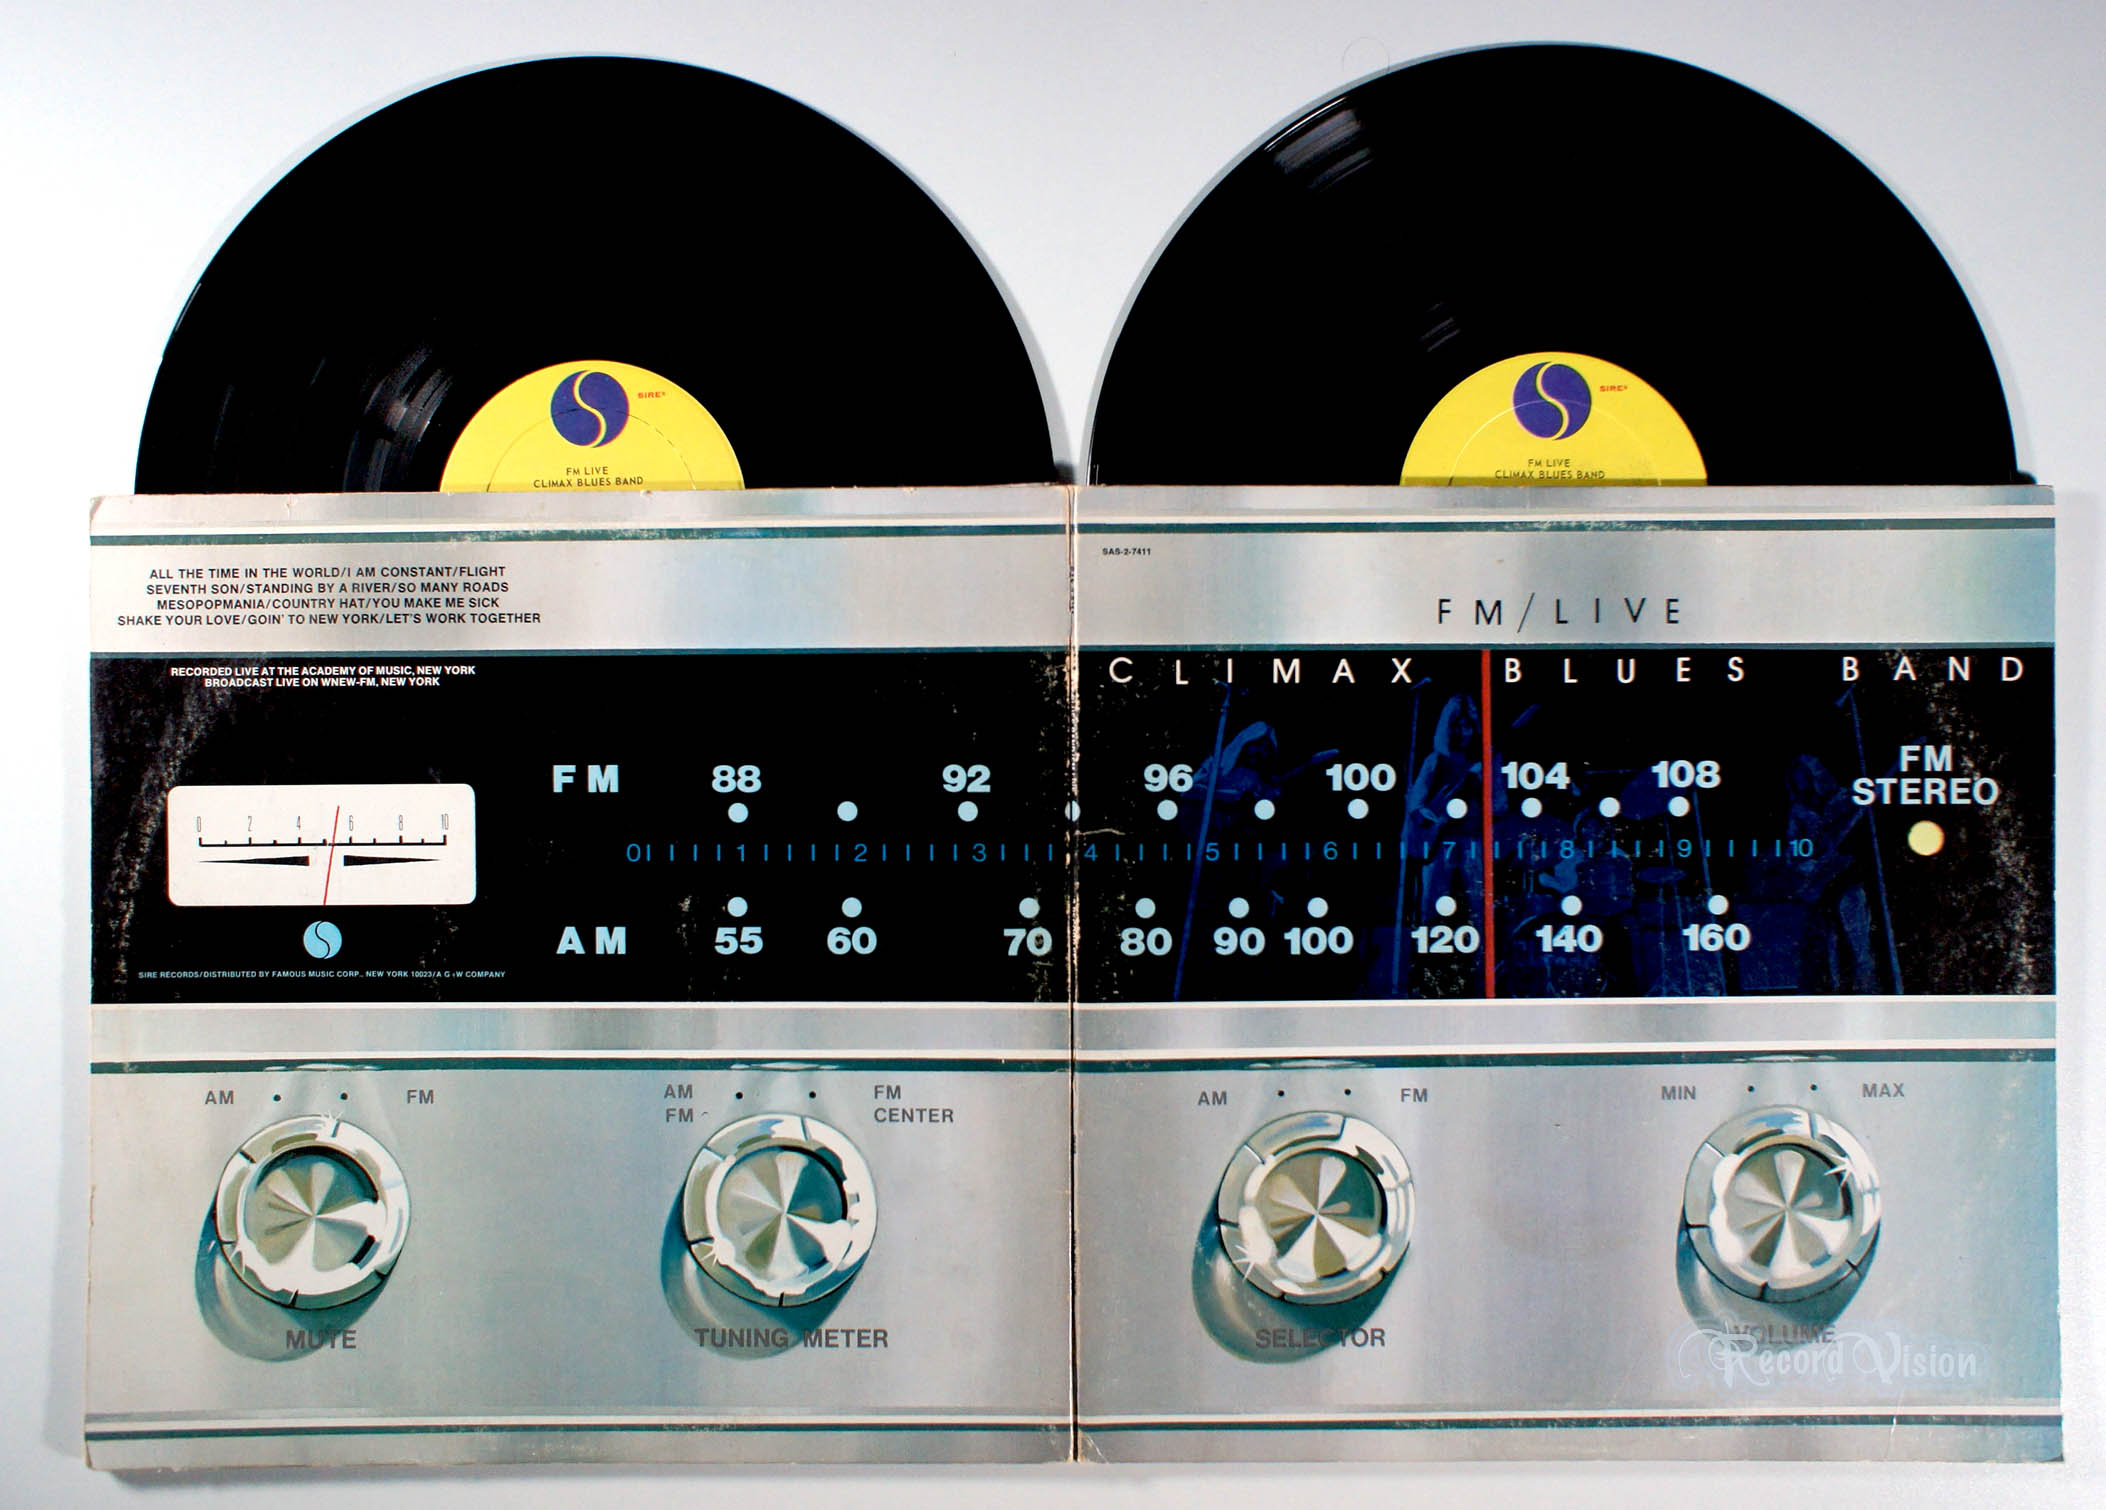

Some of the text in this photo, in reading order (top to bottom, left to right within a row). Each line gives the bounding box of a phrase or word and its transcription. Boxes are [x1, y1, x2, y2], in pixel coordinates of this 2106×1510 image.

[566, 466, 608, 475] FM LIVE
[1528, 459, 1570, 467] FM LIVE
[1495, 470, 1605, 479] CLIMAX BLUES BAND
[533, 476, 644, 489] CLIMAX BLUES BAND
[1102, 547, 1150, 555] SAS-2-7411
[149, 566, 506, 579] ALL THE TIME IN THE WORLD/I AM CONSTANT/FLIGHT
[146, 582, 509, 595] SEVENTH SON/STANDING BY A RIVER/SO MANY ROADS
[157, 597, 500, 610] MESOPOPMANIA/COUNTRY HAT/YOU MAKE ME SICK
[117, 613, 541, 626] SHAKE YOUR LOVE/GOIN' TO NEW YORK/LET'S WORK TOGETHER
[171, 666, 476, 677] RECORDED LIVE AT THE ACADEMY OF MUSIC, NEW YORK
[1109, 656, 2024, 685] CLIMAX BLUES BAND
[204, 677, 440, 688] BROADCAST LIVE ON WNEW-FM, NEW YORK
[1900, 744, 1953, 773] FM
[711, 764, 762, 793] 88
[942, 764, 991, 793] 92
[1143, 763, 1194, 793] 96
[1326, 763, 1397, 792] 100
[1501, 762, 1570, 790] 104
[1651, 760, 1722, 788] 108
[1852, 777, 1999, 806] STEREO
[197, 813, 449, 832] 0 2 4 6 8 10
[626, 839, 1813, 863] 0 1 2 3 4 5 6 7 8 9 10
[714, 927, 763, 955] 55
[827, 927, 877, 955] 60
[1003, 928, 1053, 957] 70
[1120, 927, 1173, 956] 80
[1213, 927, 1265, 956] 90
[1283, 926, 1354, 955] 100
[1410, 925, 1480, 955] 120
[1535, 924, 1603, 954] 140
[1682, 923, 1750, 952] 160
[138, 971, 158, 979] SIRE
[204, 1090, 234, 1104] AM
[406, 1089, 434, 1104] FM
[664, 1084, 693, 1099] AM
[874, 1085, 901, 1099] FM
[1198, 1091, 1227, 1105] AM
[1401, 1088, 1428, 1103] FM
[1661, 1085, 1696, 1100] MIN
[1862, 1083, 1905, 1098] MAX
[665, 1108, 694, 1123] FM
[874, 1108, 954, 1123] CENTER
[286, 1330, 357, 1349] MUTE
[694, 1328, 888, 1348] TUNING METER
[1256, 1328, 1386, 1348] SELECTOR
[1733, 1324, 1836, 1344] VOLUME
